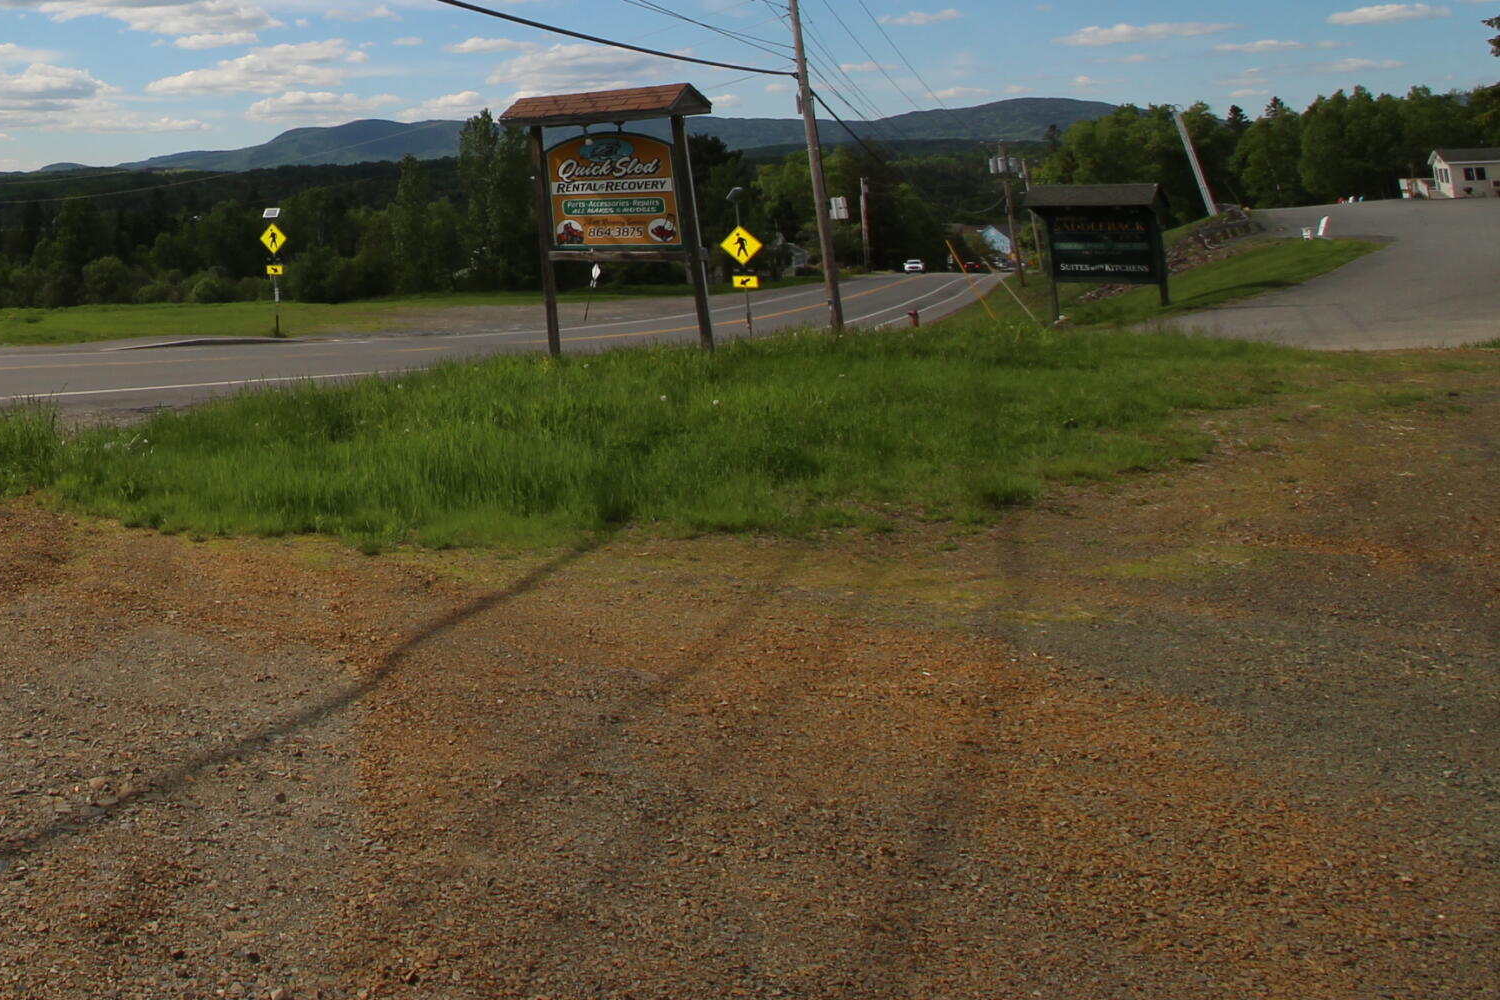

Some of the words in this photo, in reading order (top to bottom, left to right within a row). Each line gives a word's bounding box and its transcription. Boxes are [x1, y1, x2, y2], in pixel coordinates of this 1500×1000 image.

[558, 159, 613, 183] Quick
[613, 157, 660, 177] Sled
[556, 182, 598, 193] RENTAL
[605, 180, 667, 192] RECOVERY
[1105, 263, 1150, 272] KITCHENS
